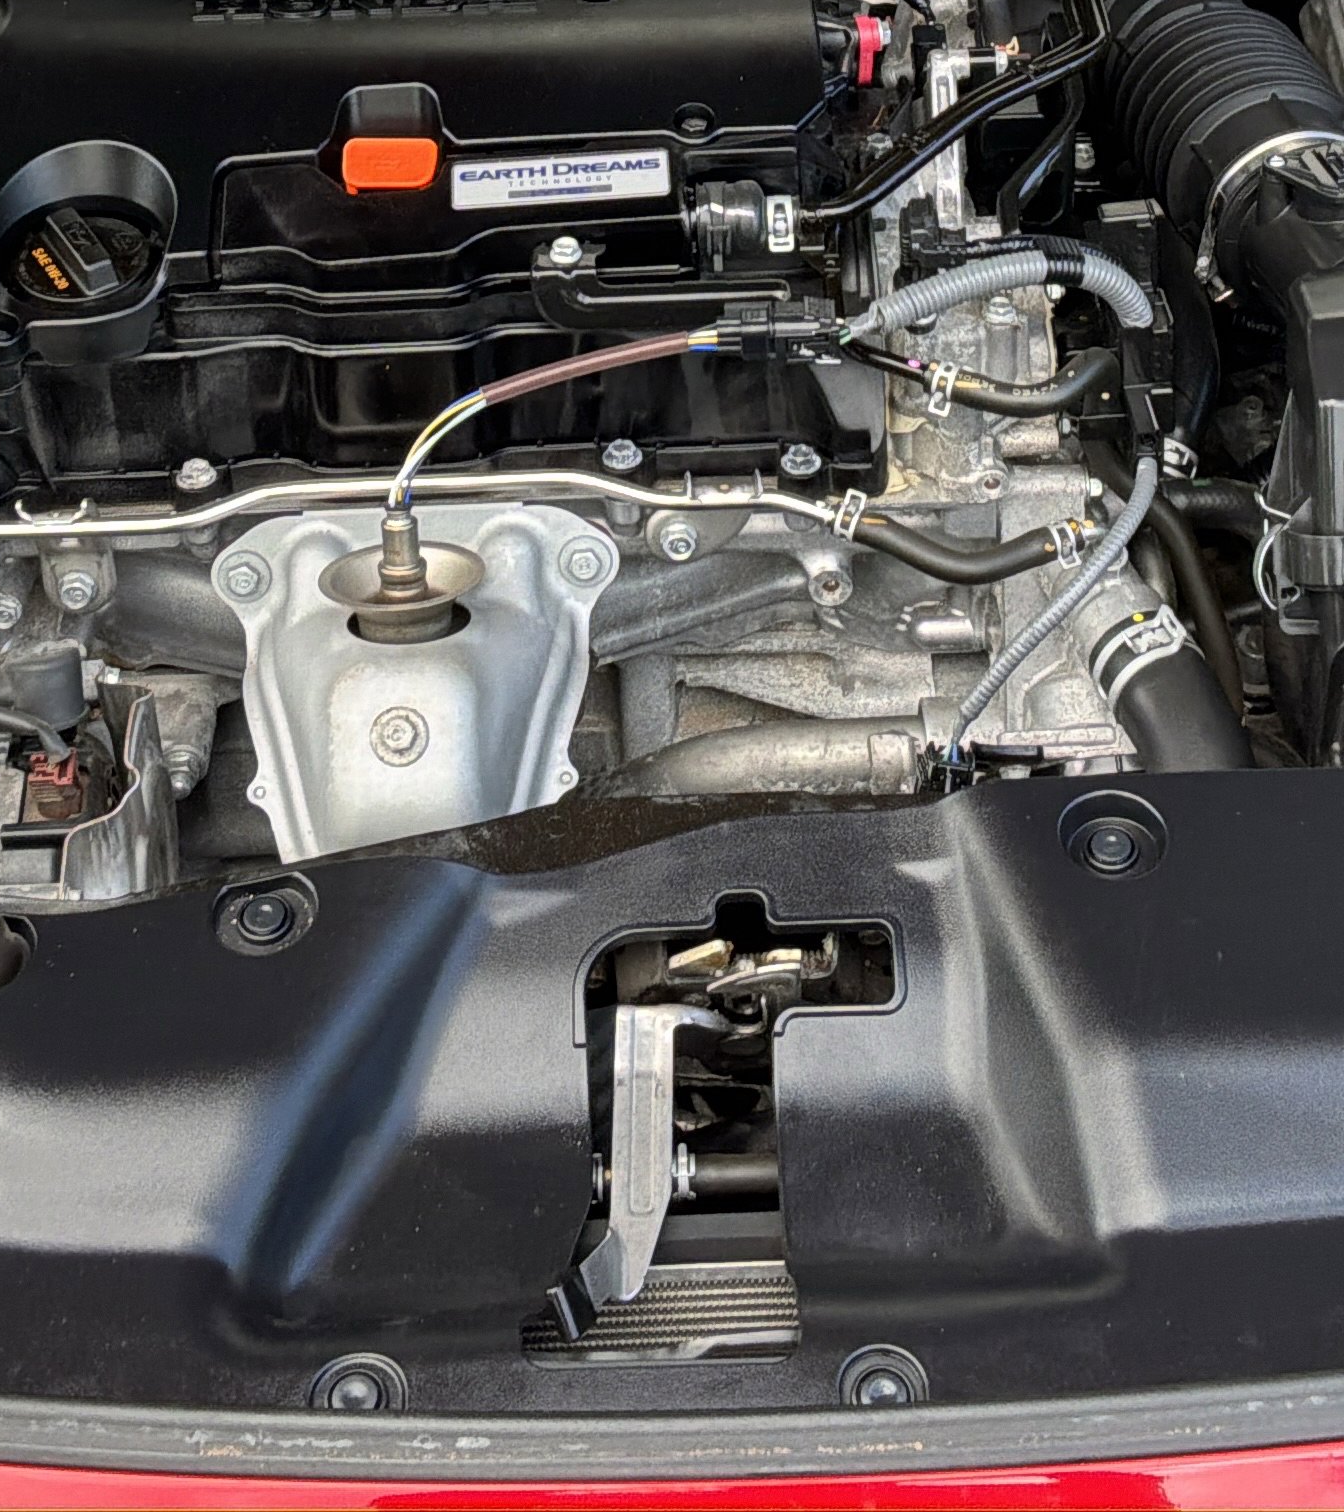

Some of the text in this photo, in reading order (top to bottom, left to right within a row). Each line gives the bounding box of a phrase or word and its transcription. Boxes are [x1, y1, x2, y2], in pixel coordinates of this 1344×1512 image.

[459, 157, 660, 182] EARTH DREAMS
[508, 175, 612, 188] TECHNOLOGY
[31, 247, 53, 267] SAE
